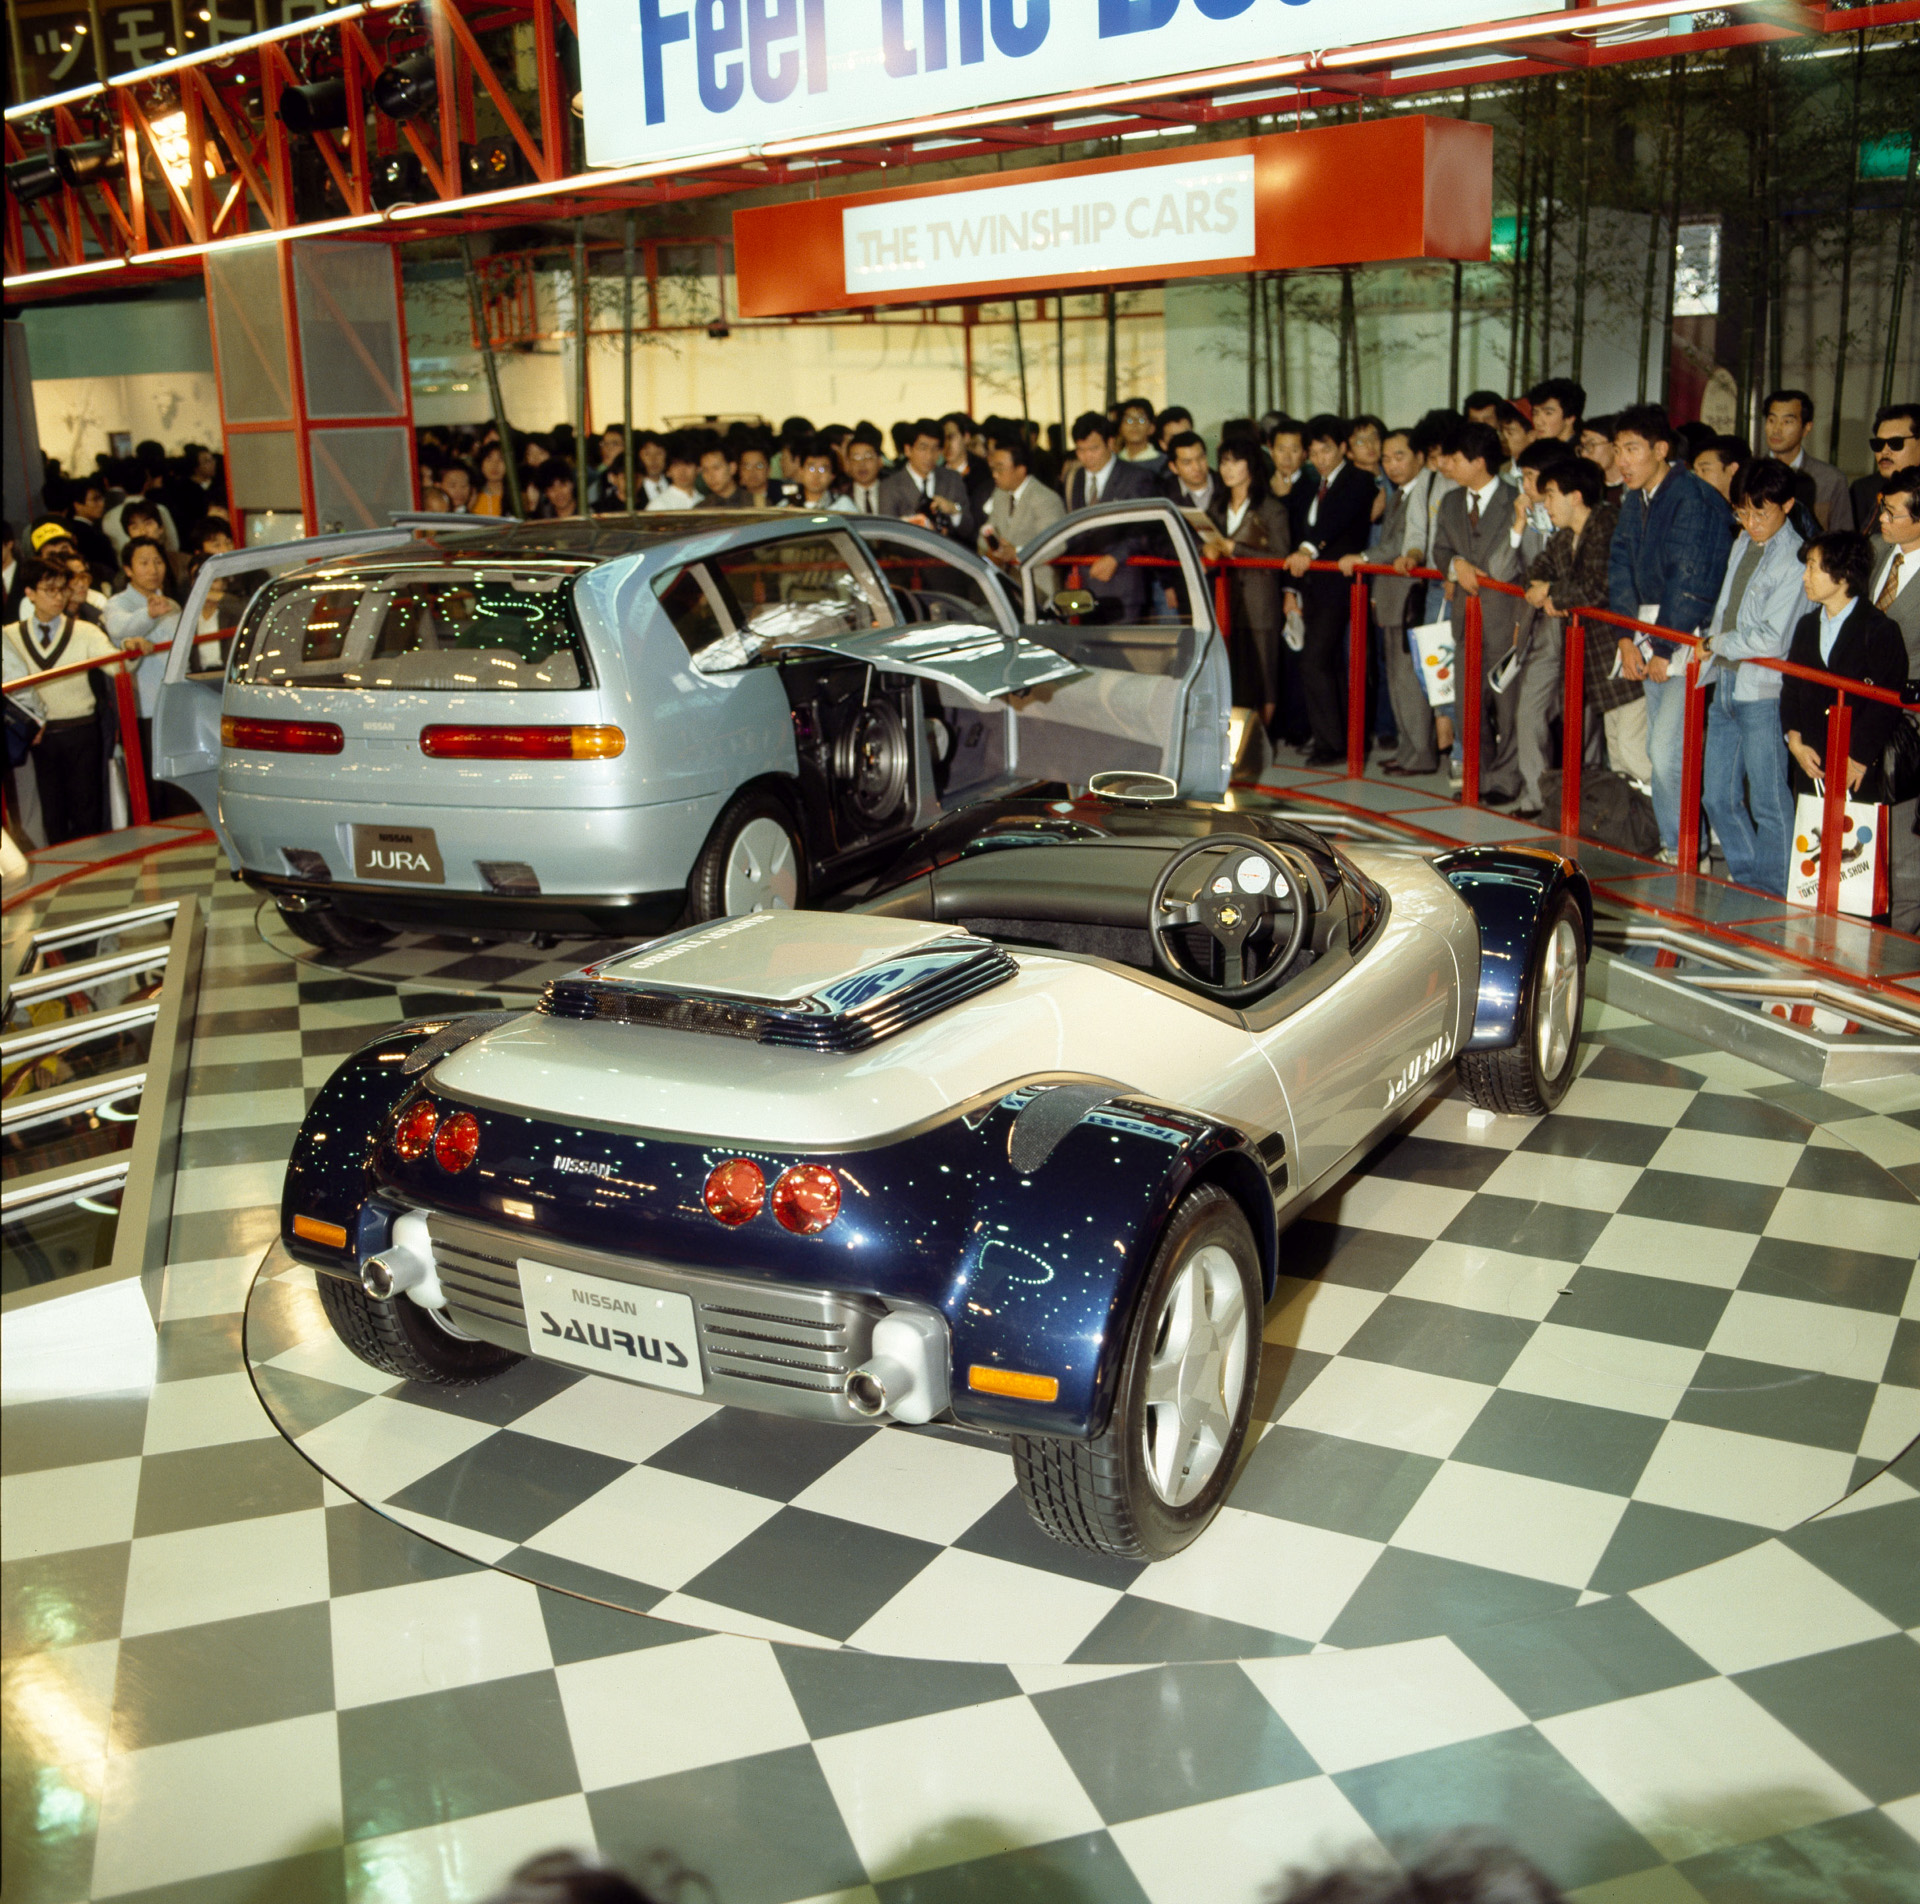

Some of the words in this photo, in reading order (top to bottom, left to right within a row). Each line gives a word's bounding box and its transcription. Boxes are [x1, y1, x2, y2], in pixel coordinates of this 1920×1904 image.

[857, 225, 918, 267] THE
[926, 202, 1117, 261] TWINSHIP
[1125, 187, 1240, 240] CARS
[363, 721, 396, 732] NISSAN
[379, 832, 414, 844] NISSAN
[365, 849, 432, 873] JURA
[1848, 861, 1870, 878] SHOW
[553, 1155, 612, 1178] NISSAN
[572, 1288, 638, 1317] NISSAN
[540, 1310, 689, 1369] SAURUS
